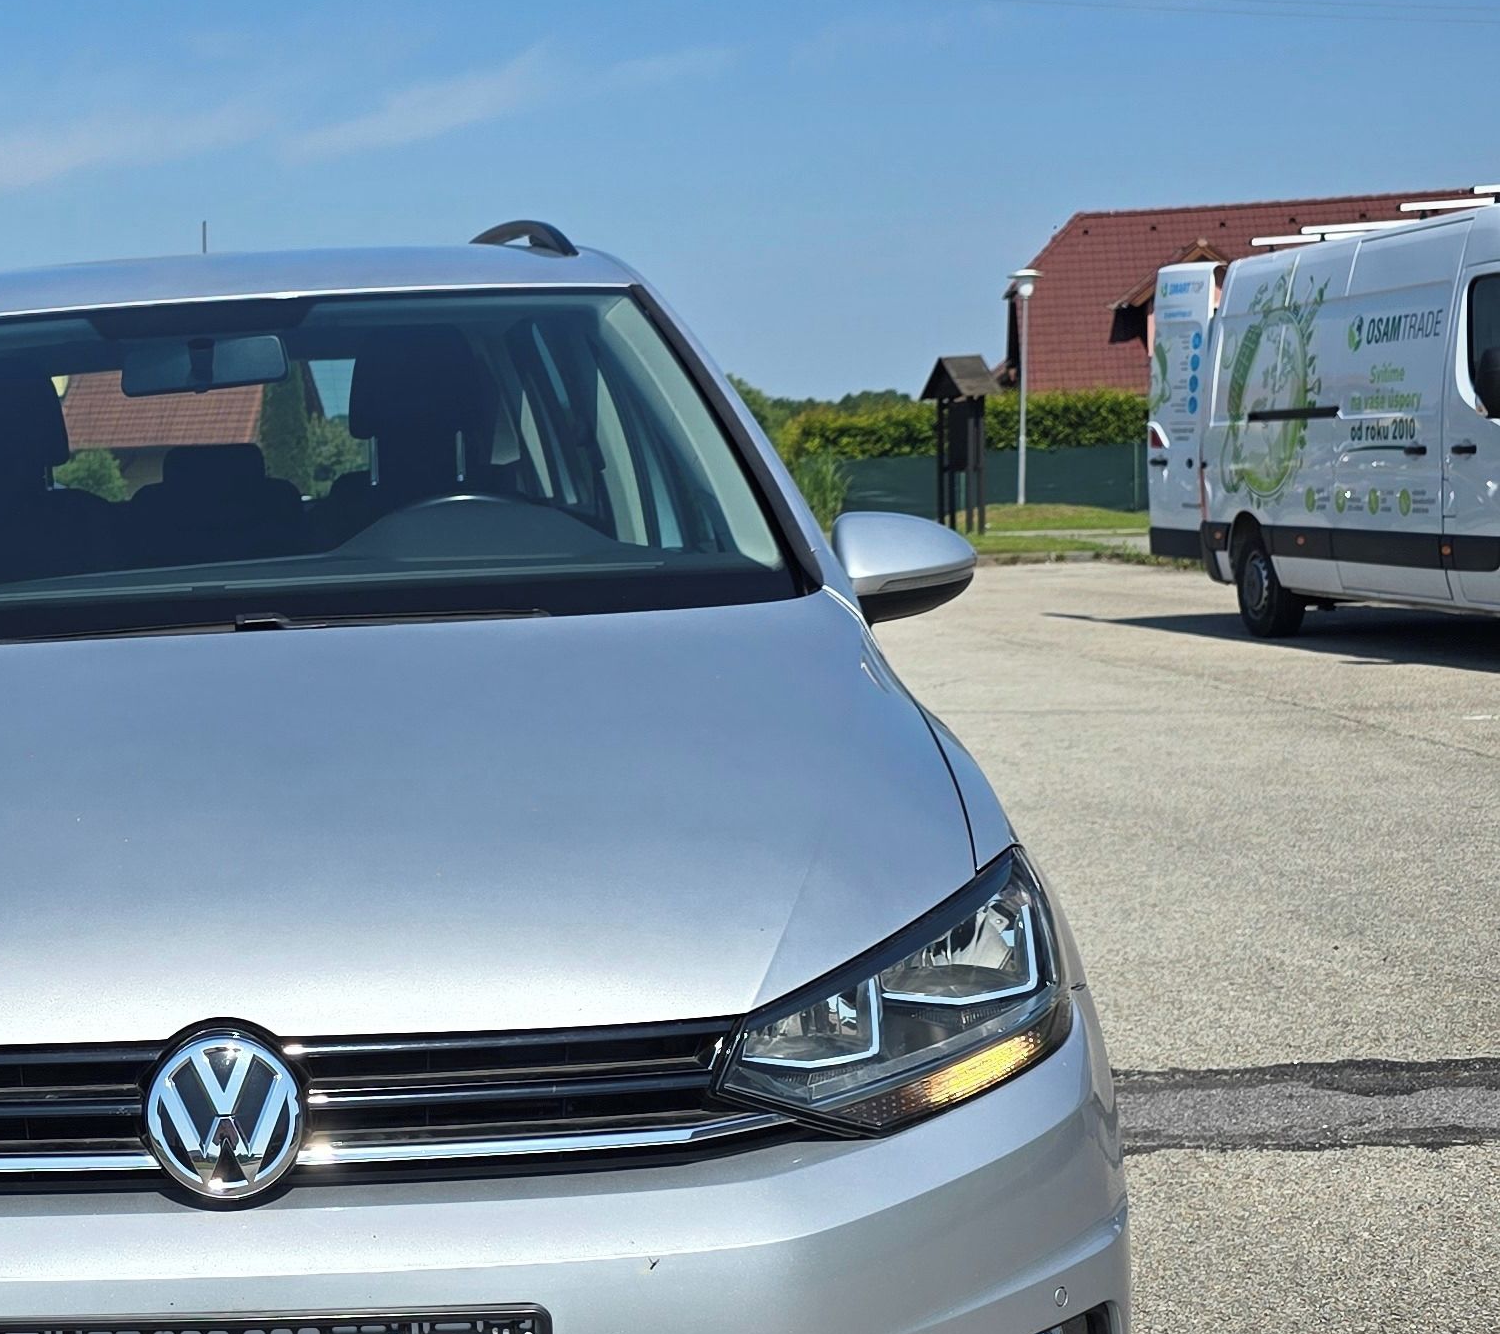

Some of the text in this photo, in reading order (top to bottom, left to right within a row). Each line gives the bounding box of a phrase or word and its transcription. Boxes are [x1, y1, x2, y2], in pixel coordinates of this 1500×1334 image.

[1366, 309, 1443, 345] OSAMTRADE
[1350, 418, 1416, 441] od roku 2010
